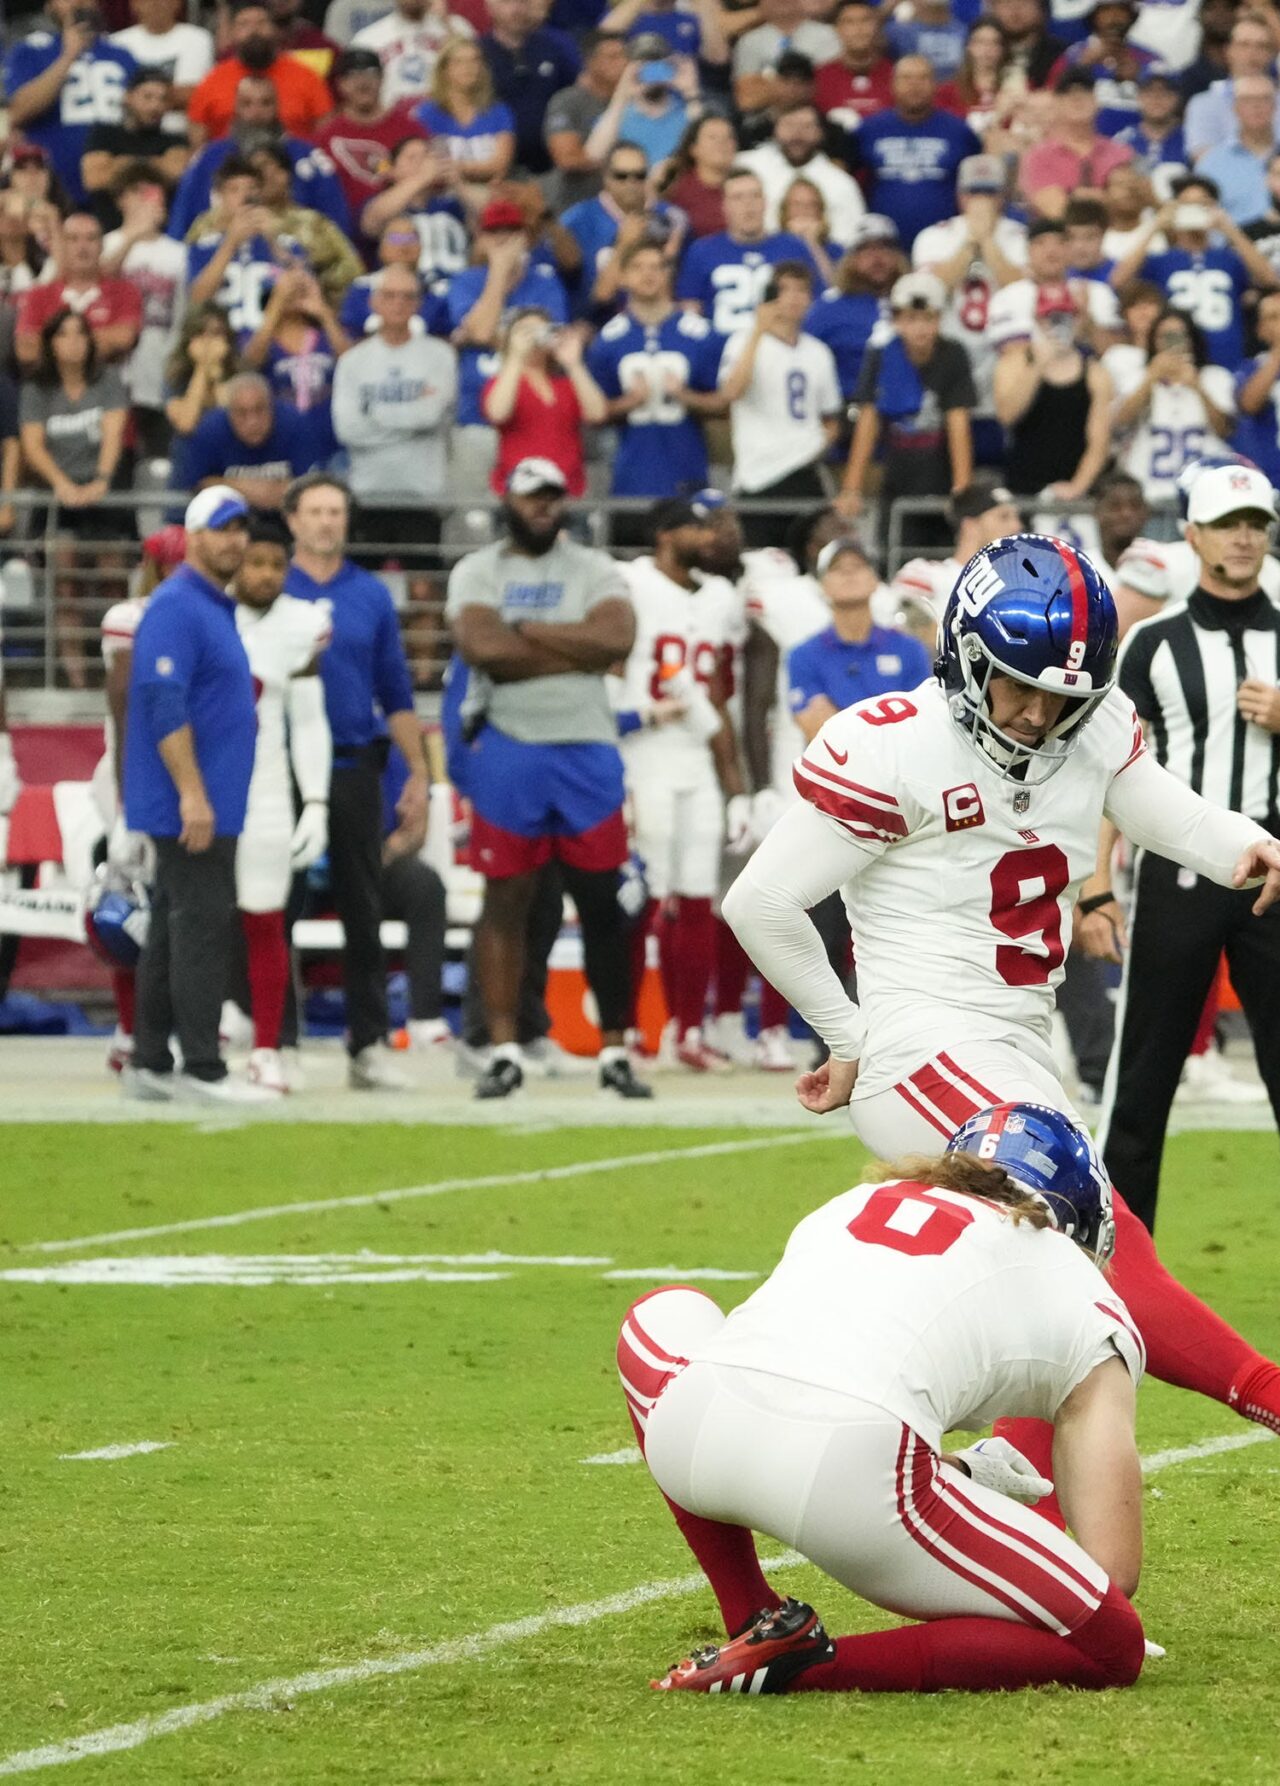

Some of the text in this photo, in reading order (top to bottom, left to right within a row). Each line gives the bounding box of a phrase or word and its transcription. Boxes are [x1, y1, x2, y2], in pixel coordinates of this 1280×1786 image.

[1066, 640, 1085, 669] 9
[855, 697, 917, 727] 9
[945, 786, 981, 821] C
[989, 843, 1069, 988] 9
[979, 1134, 1000, 1159] 6
[846, 1179, 975, 1258] 6
